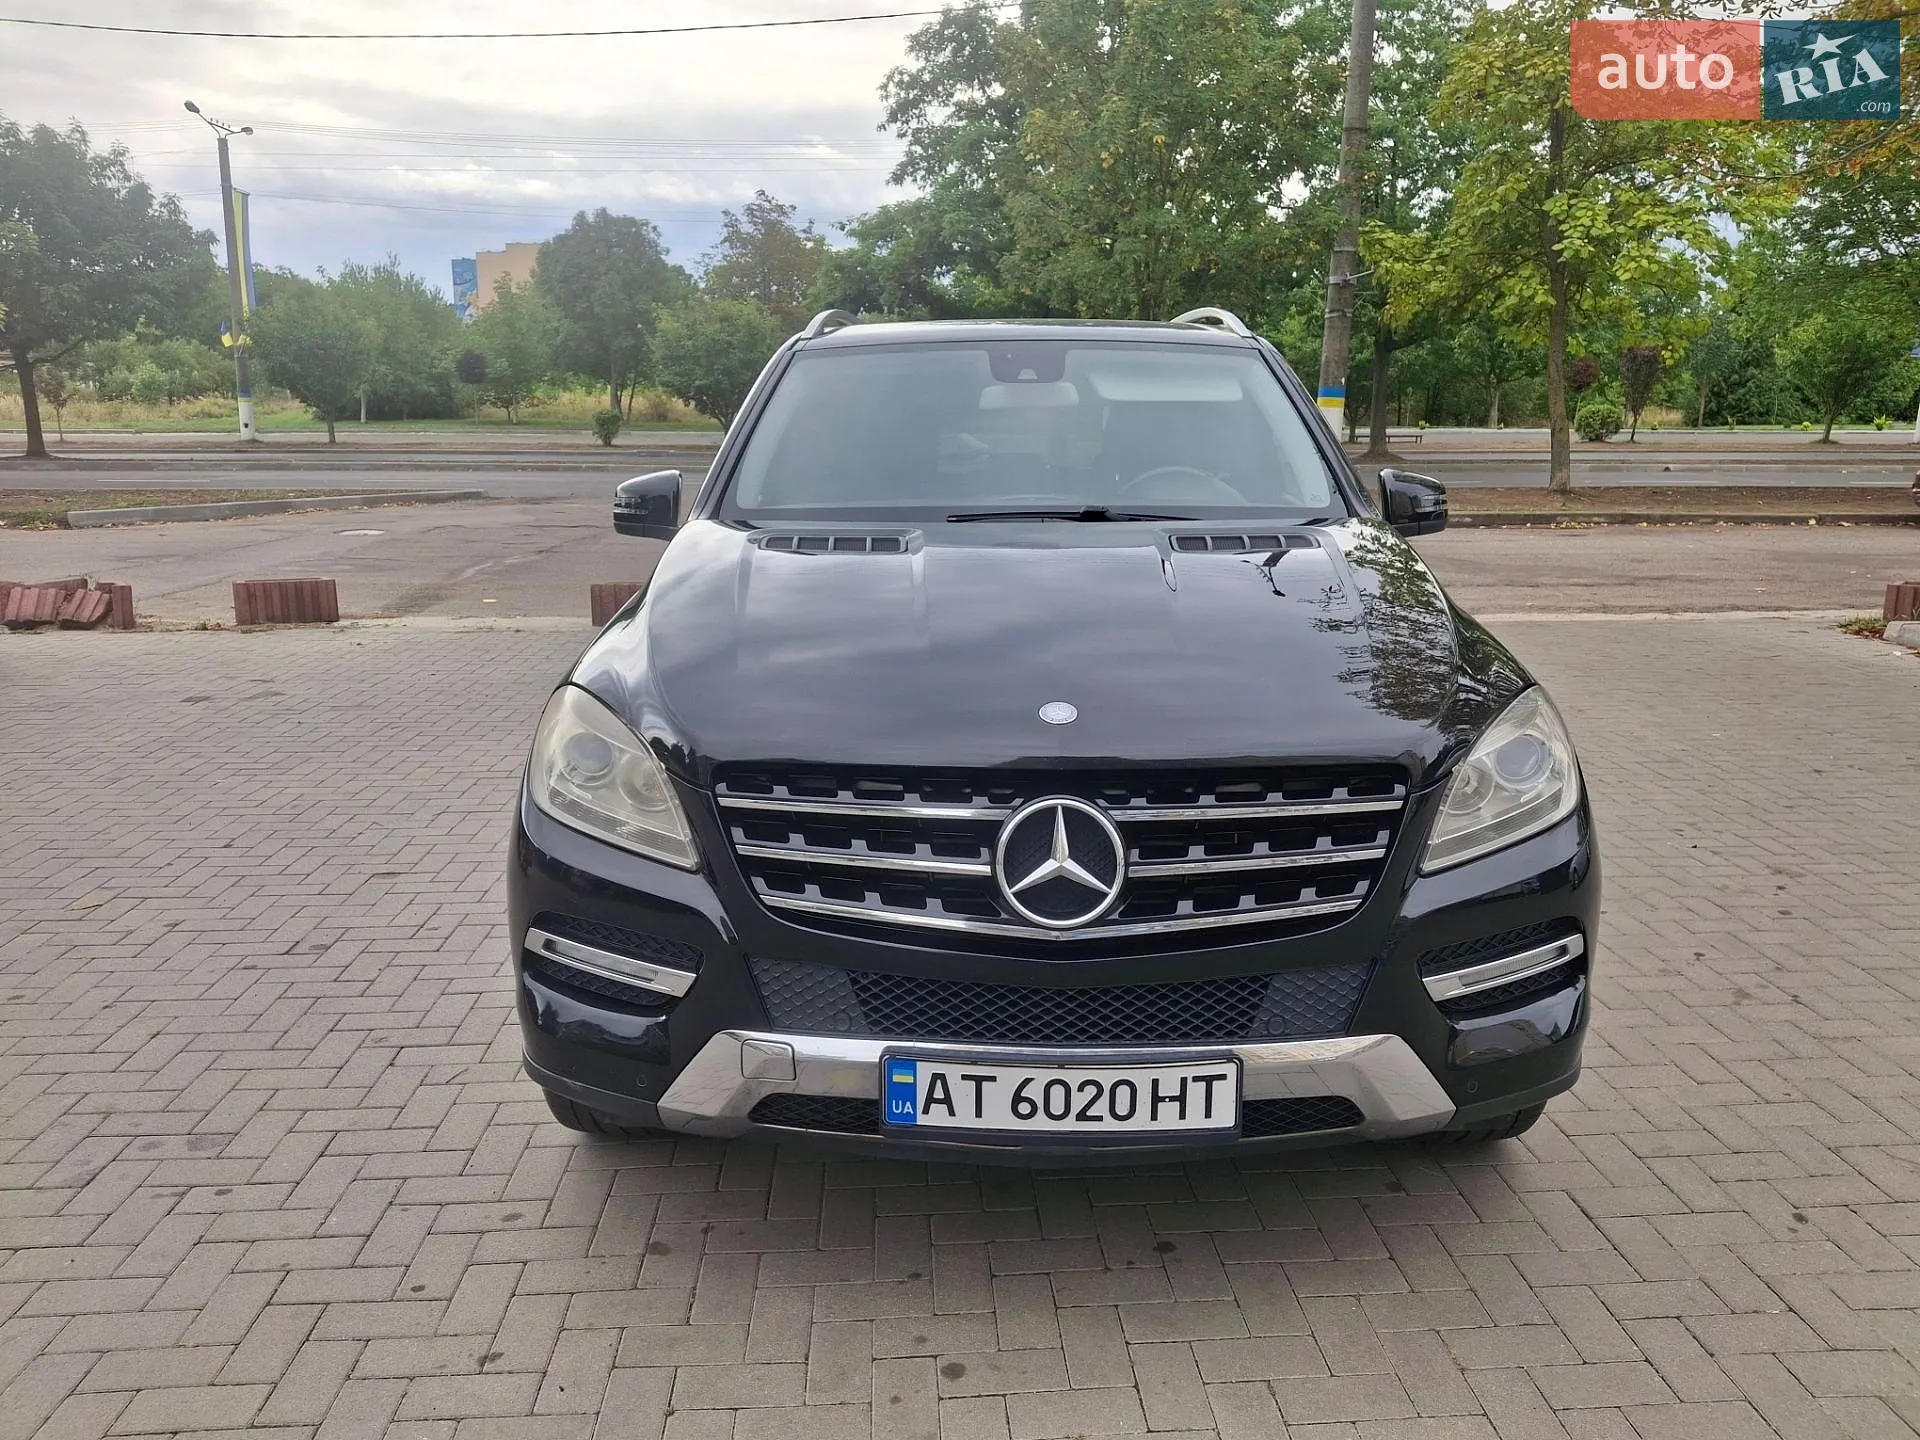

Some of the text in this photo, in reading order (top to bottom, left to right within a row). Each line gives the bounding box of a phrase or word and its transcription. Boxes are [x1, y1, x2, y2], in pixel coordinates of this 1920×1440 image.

[892, 1099, 914, 1115] UA
[920, 1071, 1228, 1122] AT 6020 HT
